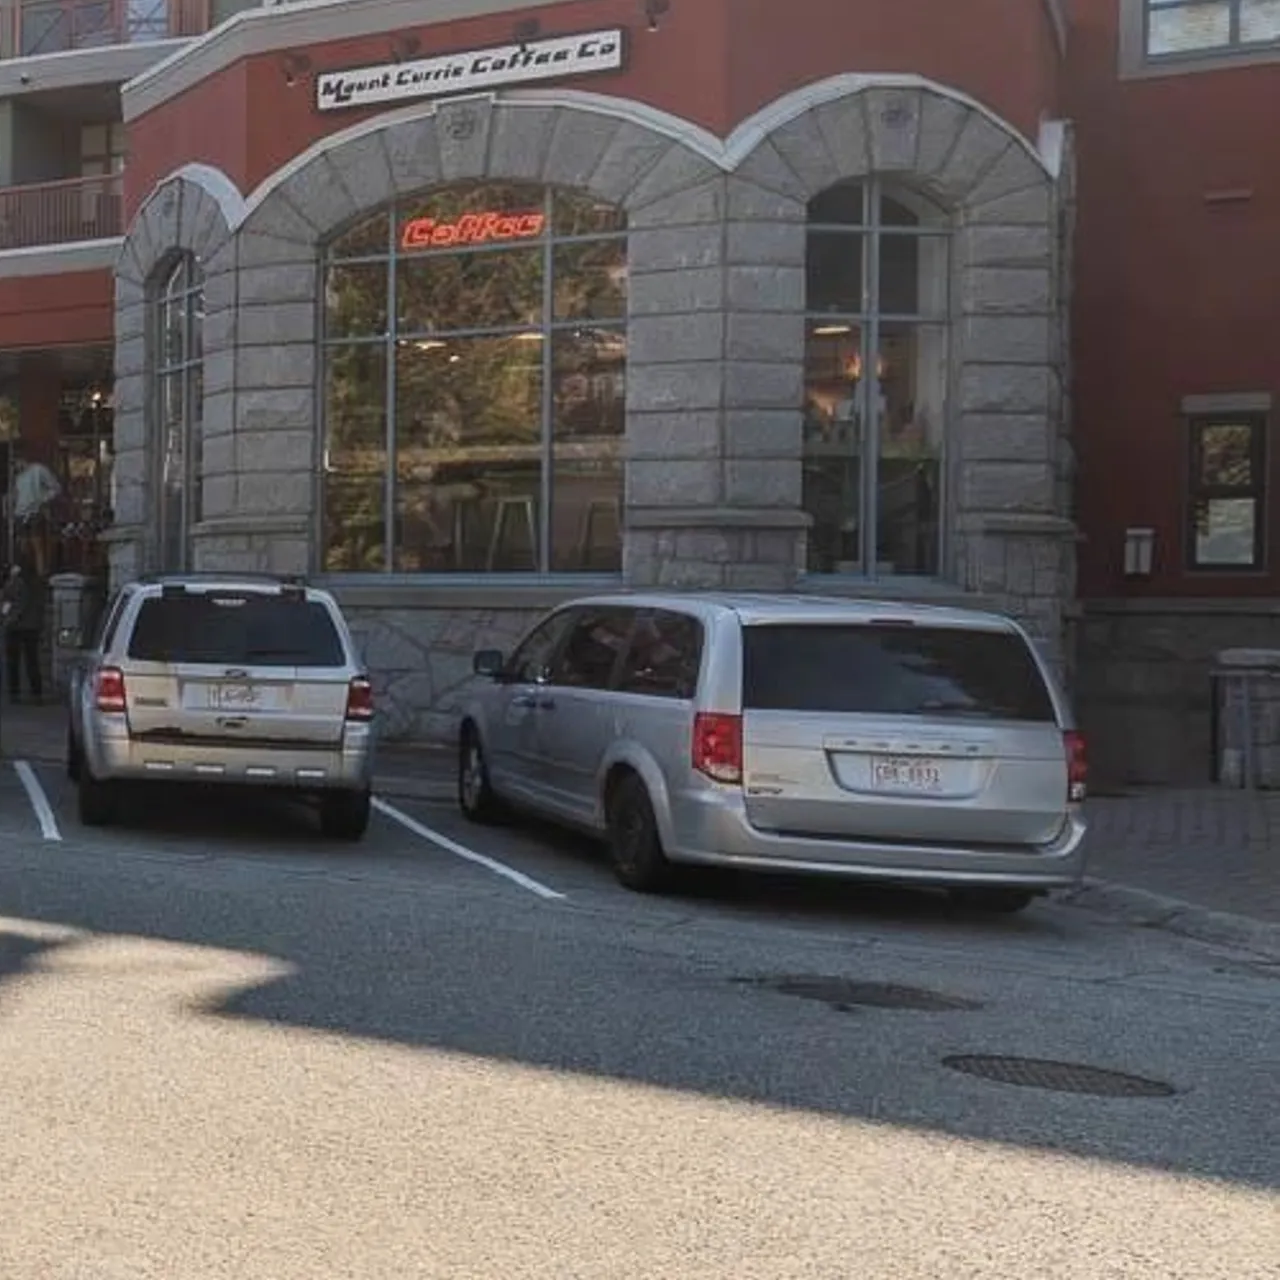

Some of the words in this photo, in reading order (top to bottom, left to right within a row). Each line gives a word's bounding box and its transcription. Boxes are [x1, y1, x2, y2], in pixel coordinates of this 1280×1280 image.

[321, 75, 389, 103] Mount
[395, 63, 463, 86] Currie
[470, 47, 569, 75] Coffee
[577, 39, 617, 58] Co
[401, 212, 544, 248] Coffee
